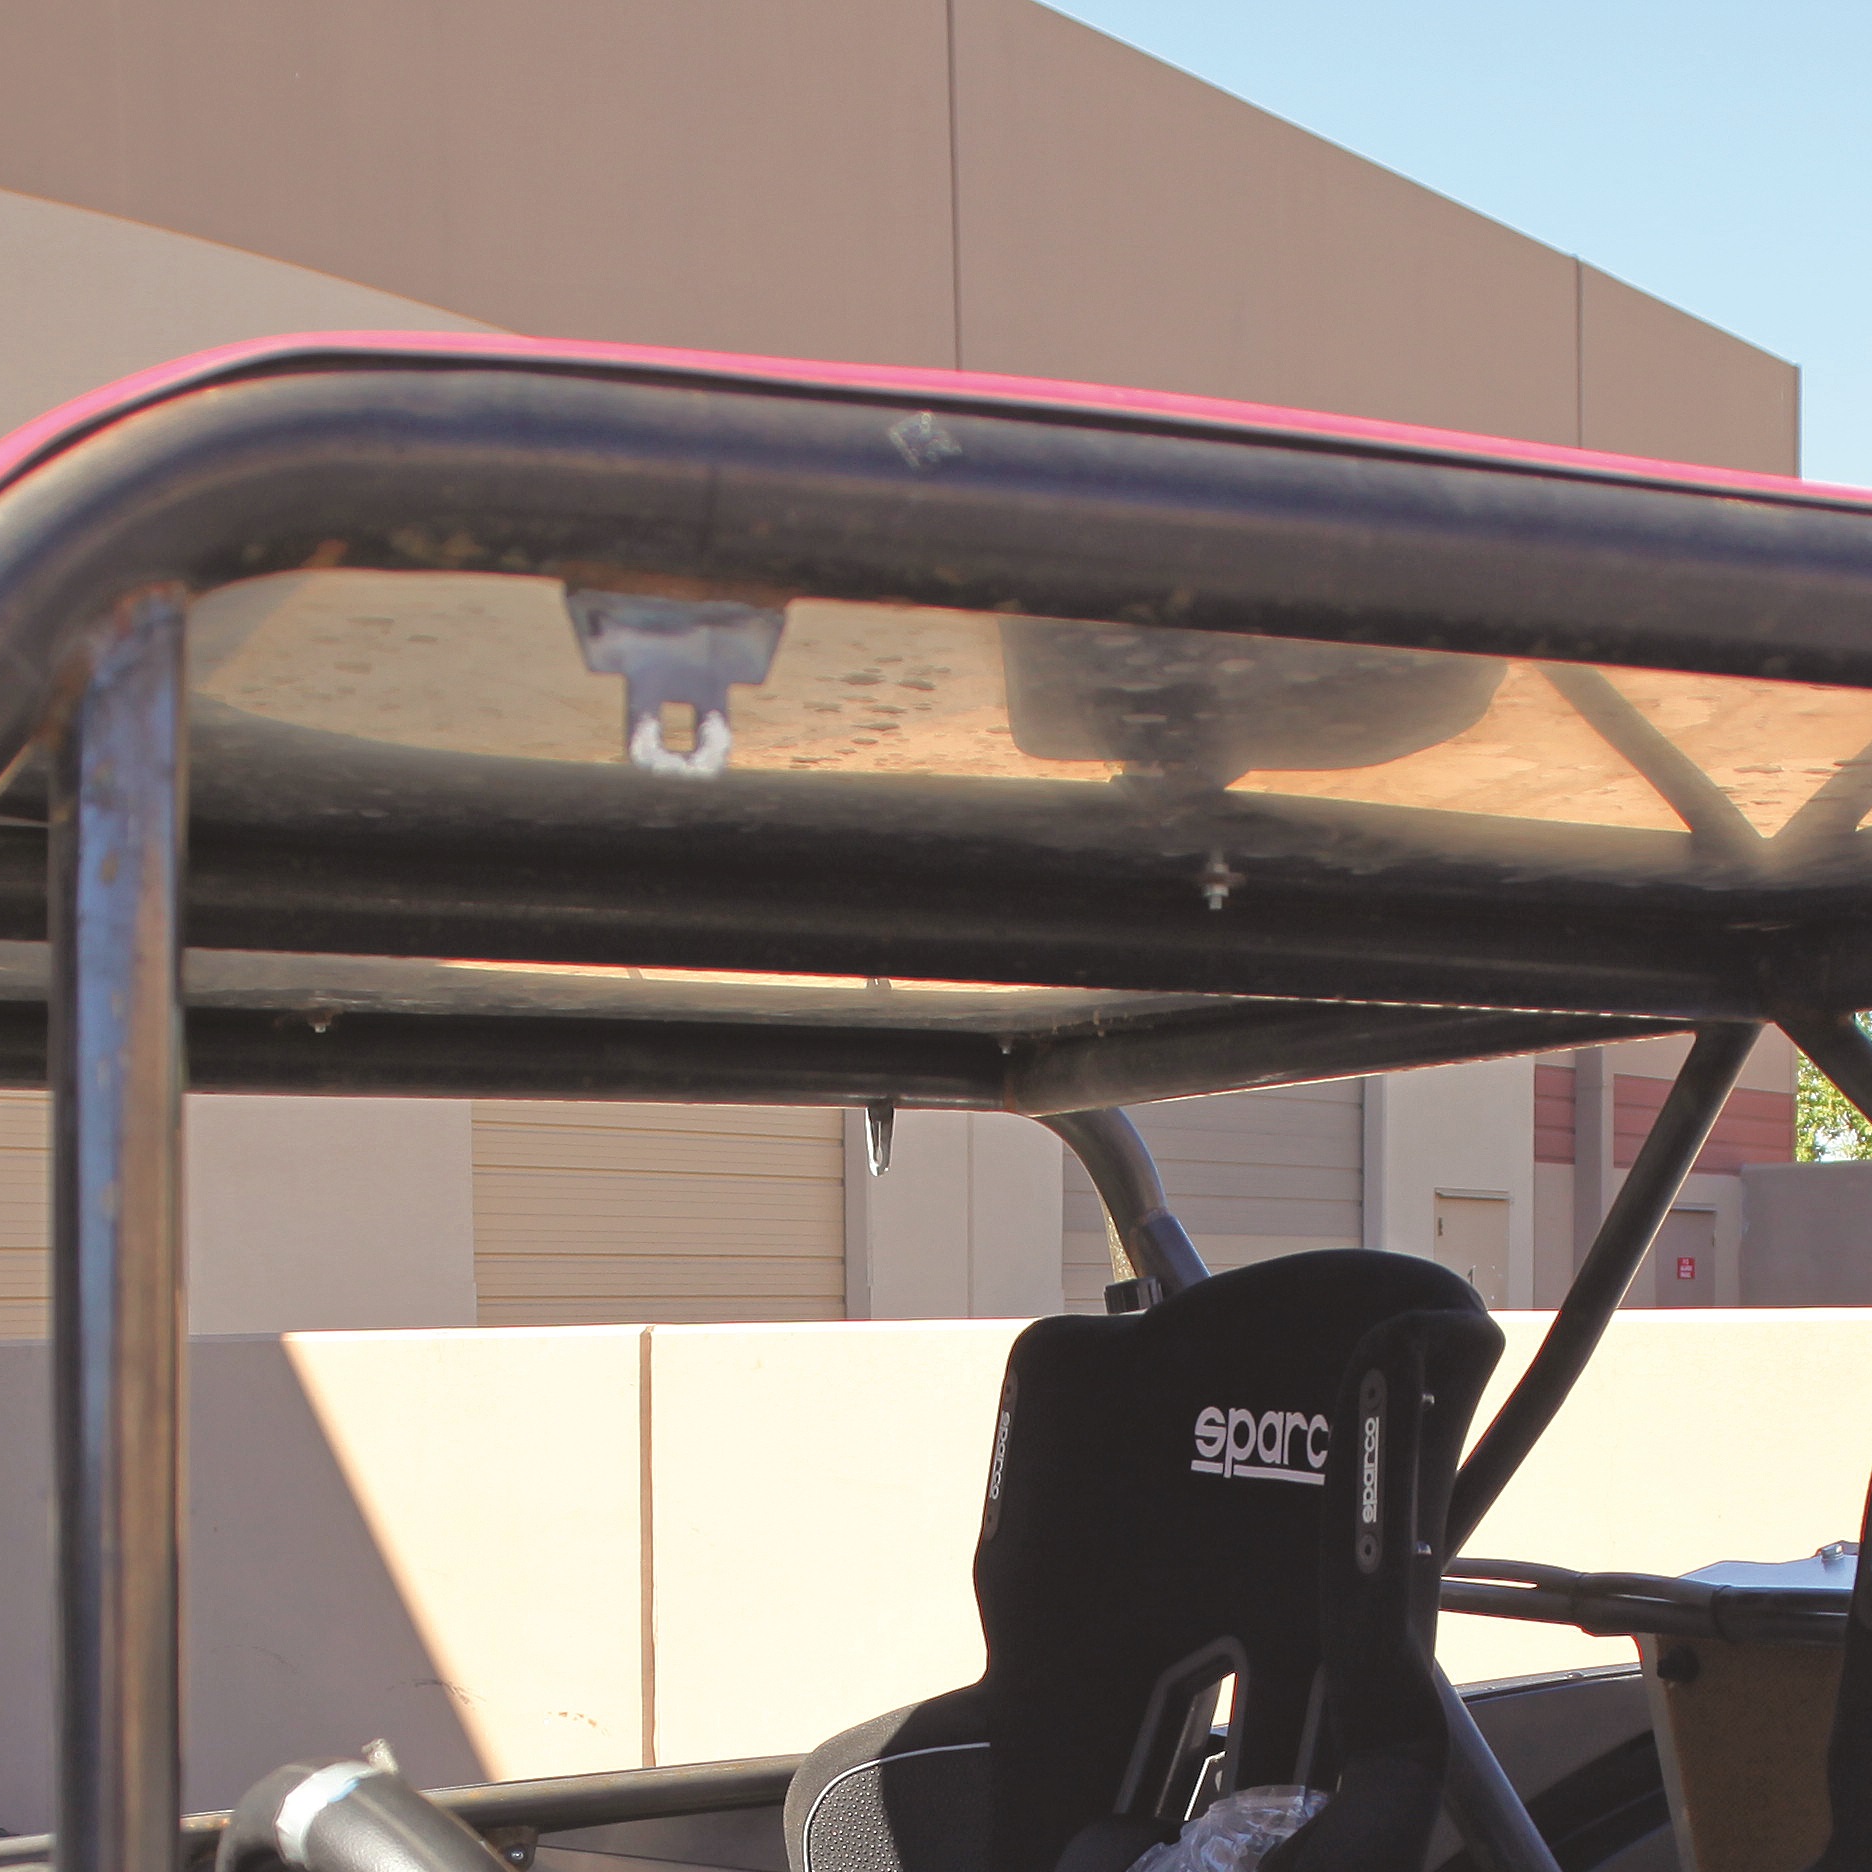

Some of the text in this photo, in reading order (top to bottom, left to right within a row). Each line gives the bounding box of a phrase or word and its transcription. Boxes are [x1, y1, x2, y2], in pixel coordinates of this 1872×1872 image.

[989, 1410, 1011, 1500] sparco
[1191, 1406, 1332, 1486] sparc
[1362, 1416, 1380, 1524] sparco
